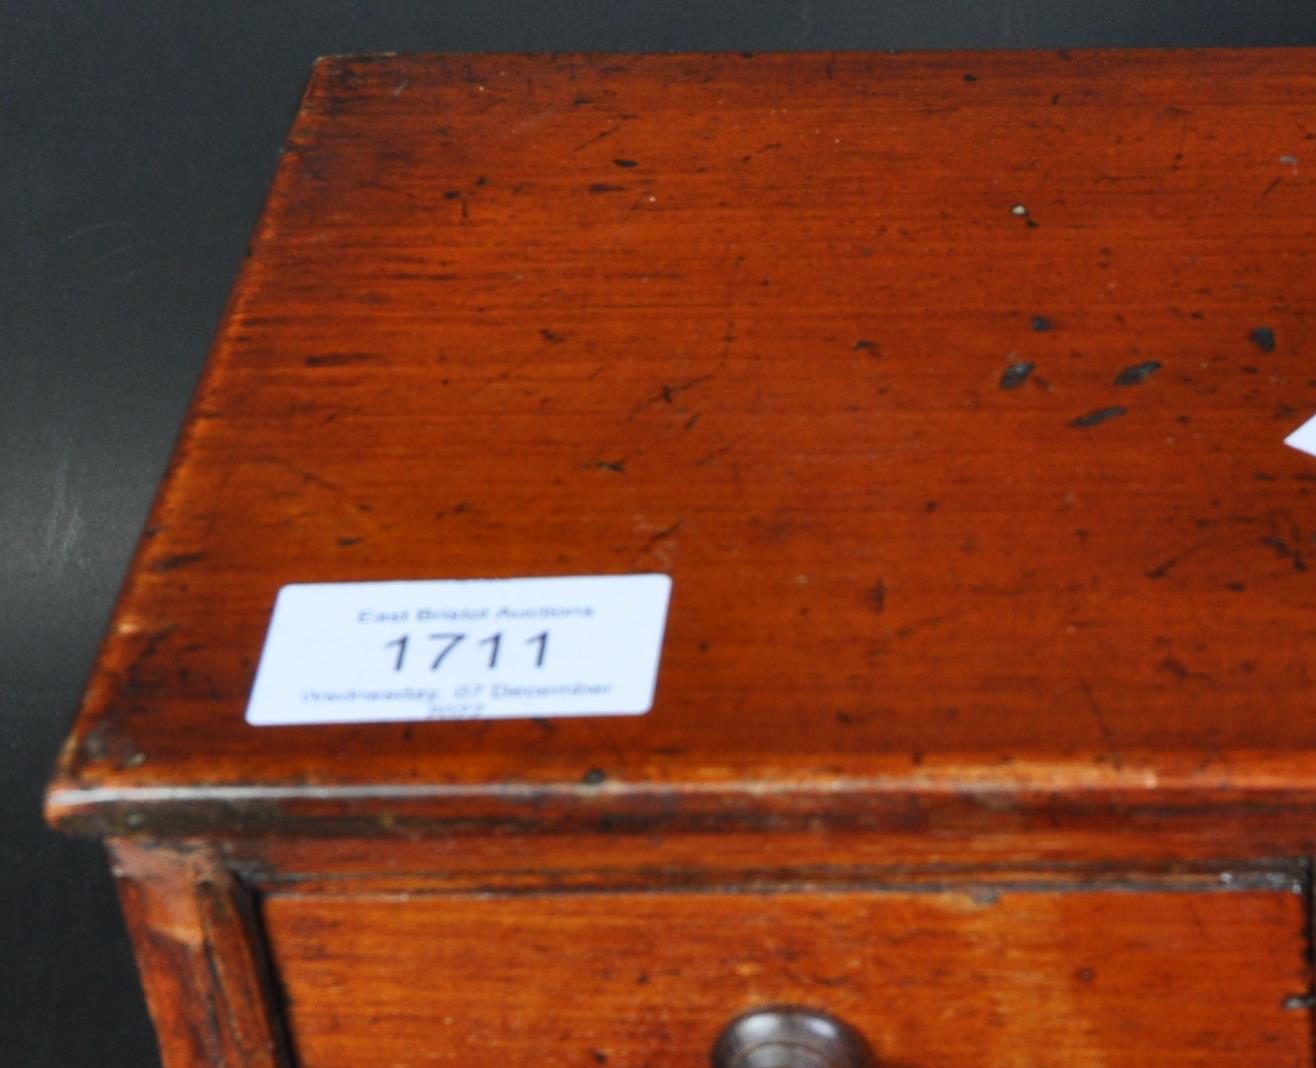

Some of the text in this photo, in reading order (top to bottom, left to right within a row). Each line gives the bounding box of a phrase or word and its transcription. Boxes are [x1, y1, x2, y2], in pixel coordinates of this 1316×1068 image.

[358, 605, 594, 623] East Bristol Auctions
[384, 631, 549, 672] 1711
[491, 682, 612, 699] December
